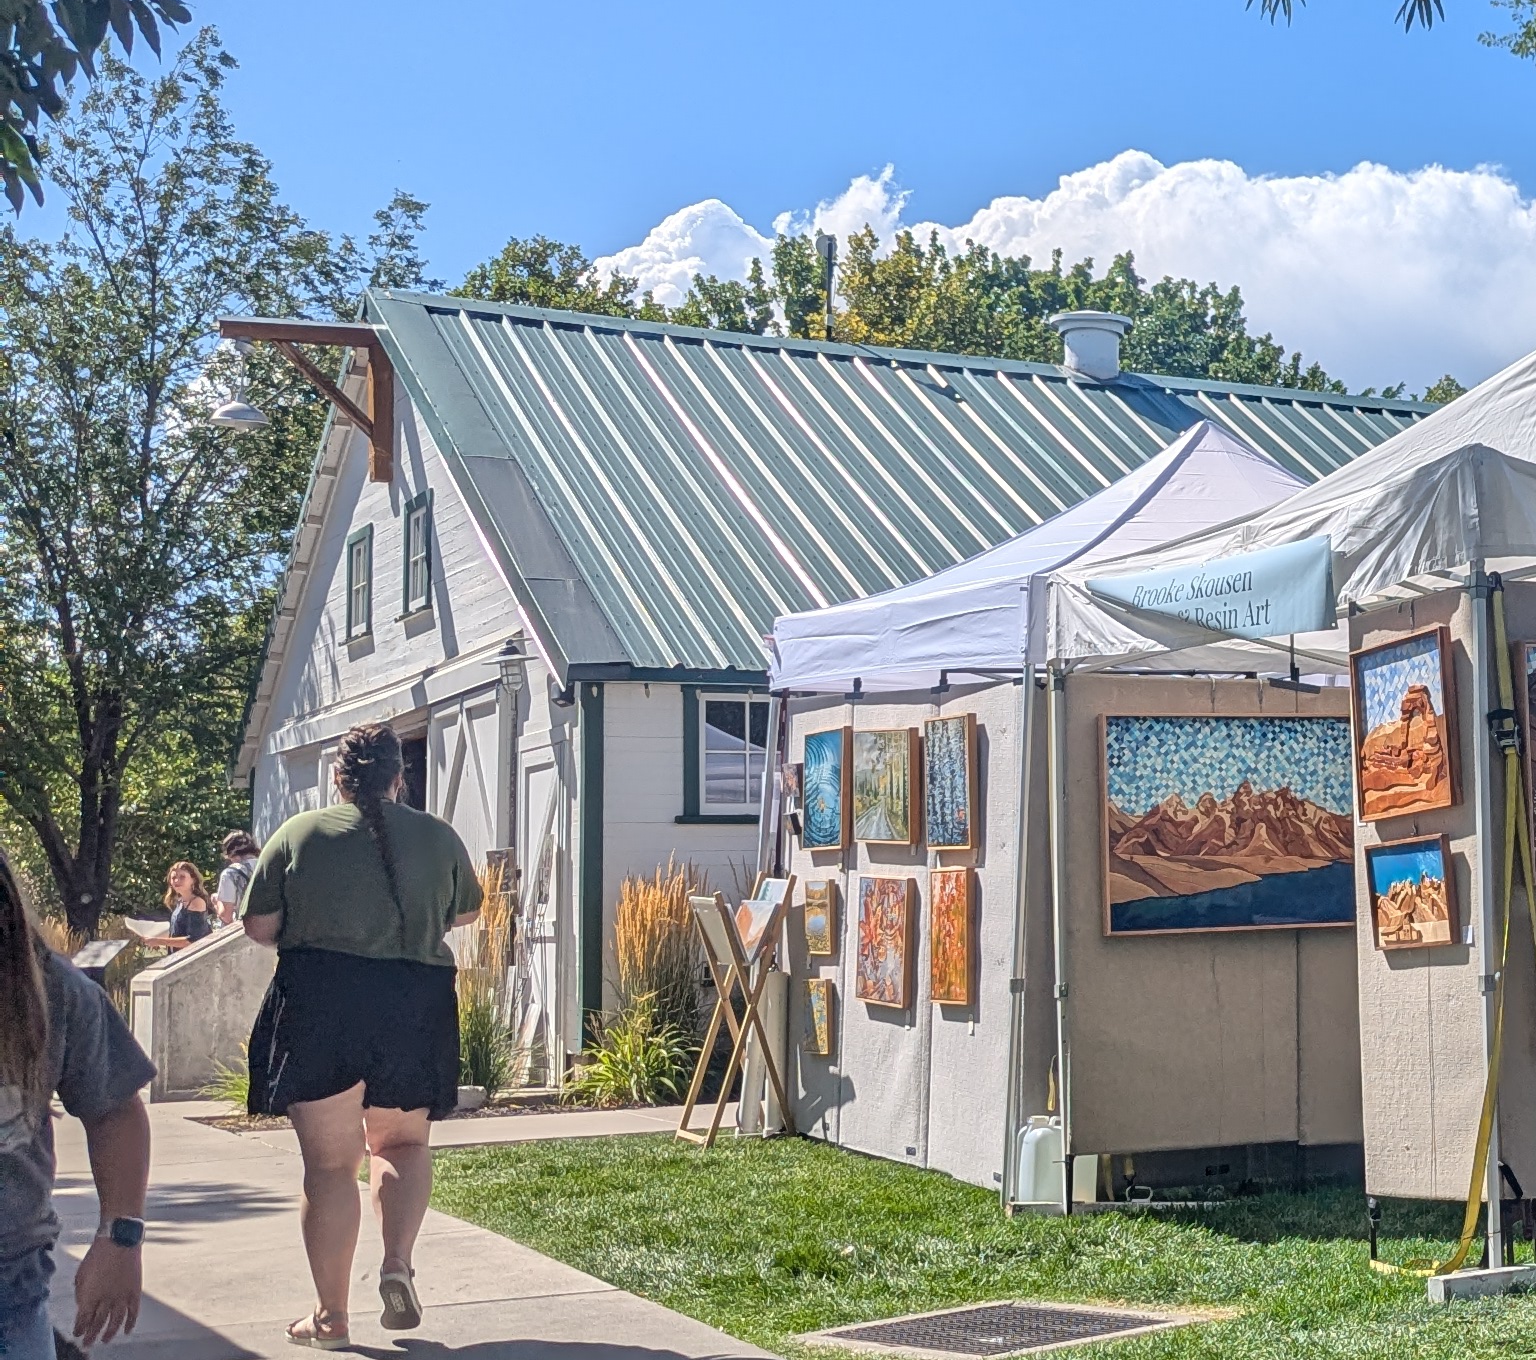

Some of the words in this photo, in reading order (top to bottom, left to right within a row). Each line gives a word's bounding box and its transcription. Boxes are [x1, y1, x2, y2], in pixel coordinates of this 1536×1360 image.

[1131, 578, 1185, 608] Brooke
[1185, 569, 1253, 601] Skousen
[1194, 601, 1239, 632] Resin
[1241, 598, 1272, 628] Art
